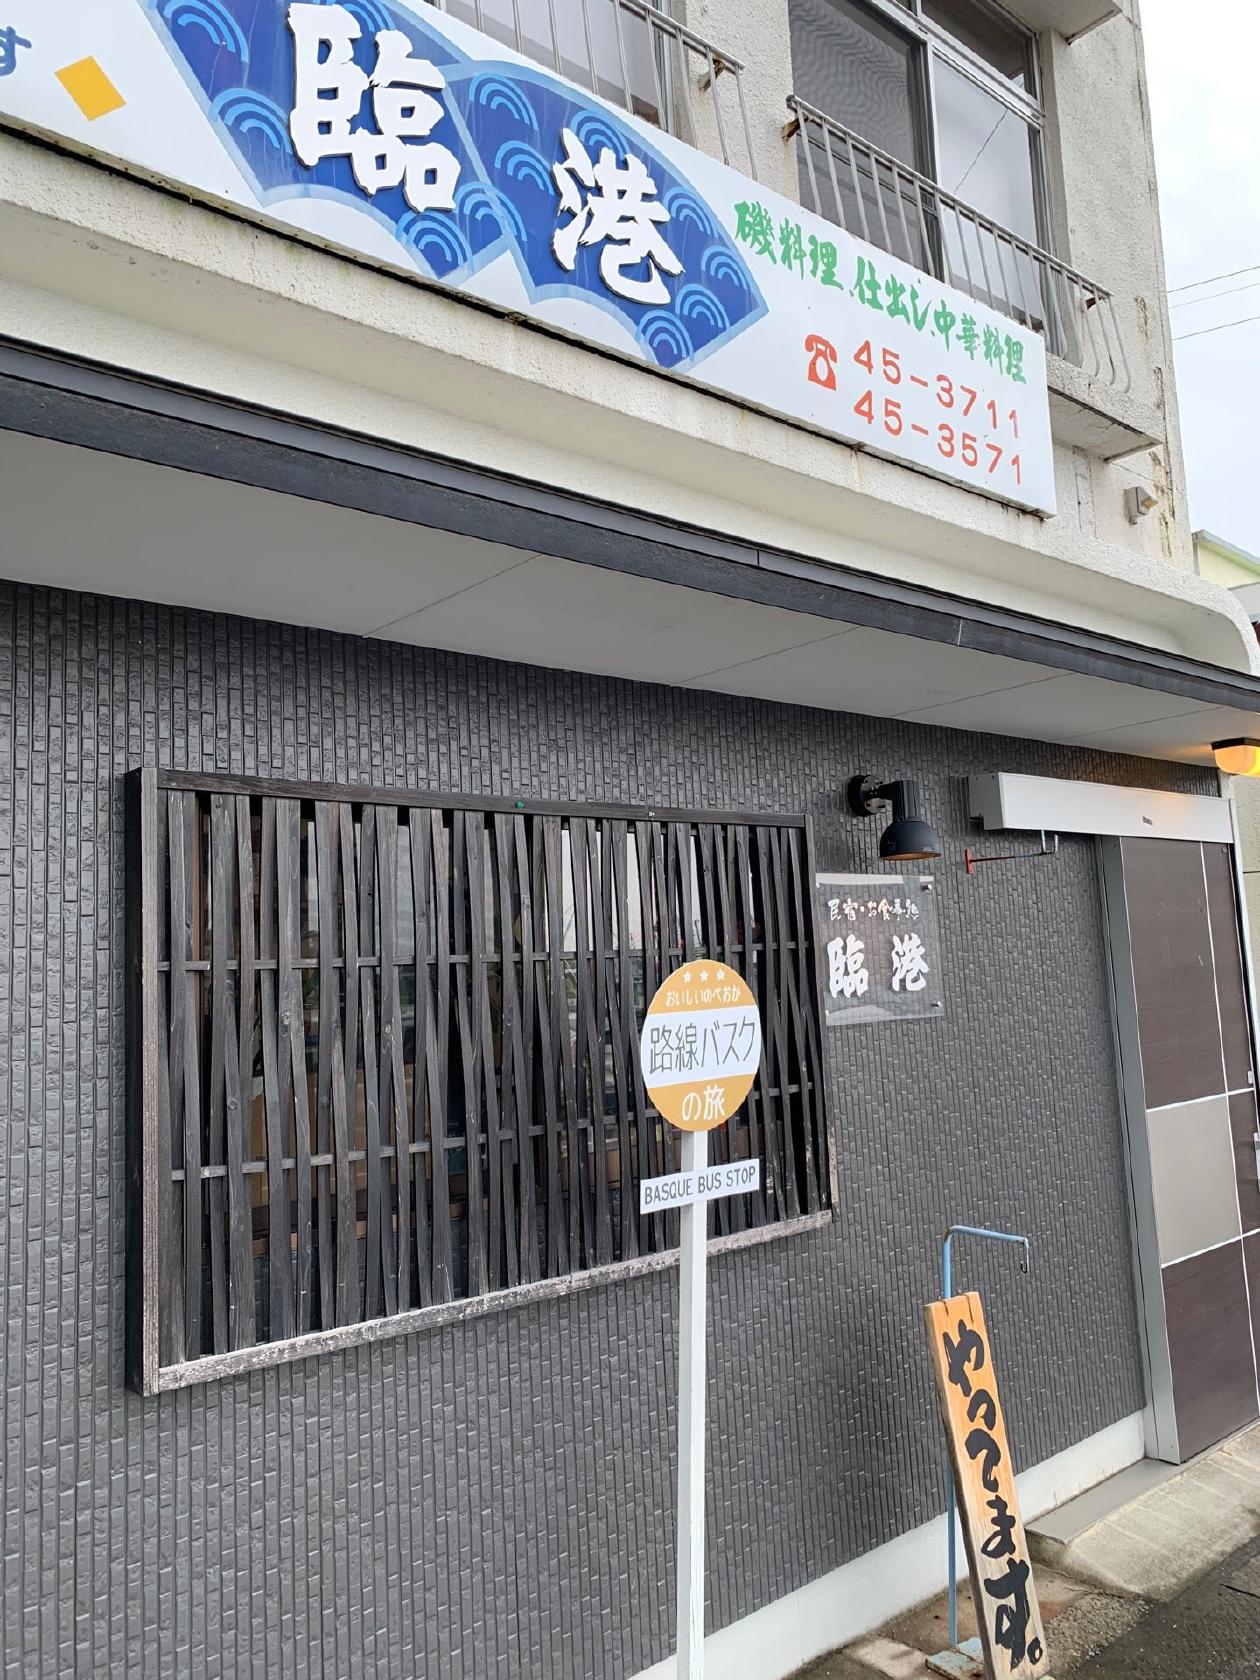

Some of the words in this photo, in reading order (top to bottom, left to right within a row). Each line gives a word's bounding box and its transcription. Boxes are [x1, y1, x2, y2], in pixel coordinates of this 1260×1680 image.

[287, 2, 685, 305] 臨港
[853, 340, 1019, 438] 45-3711
[853, 390, 1021, 485] 45-3571
[665, 984, 741, 1007] おいしいのべおか
[827, 932, 929, 998] 臨港
[649, 1015, 755, 1075] 路線バスク
[681, 1084, 725, 1122] の旅
[644, 1178, 693, 1205] BASQUE
[697, 1173, 722, 1194] BUS
[726, 1165, 756, 1187] STOP
